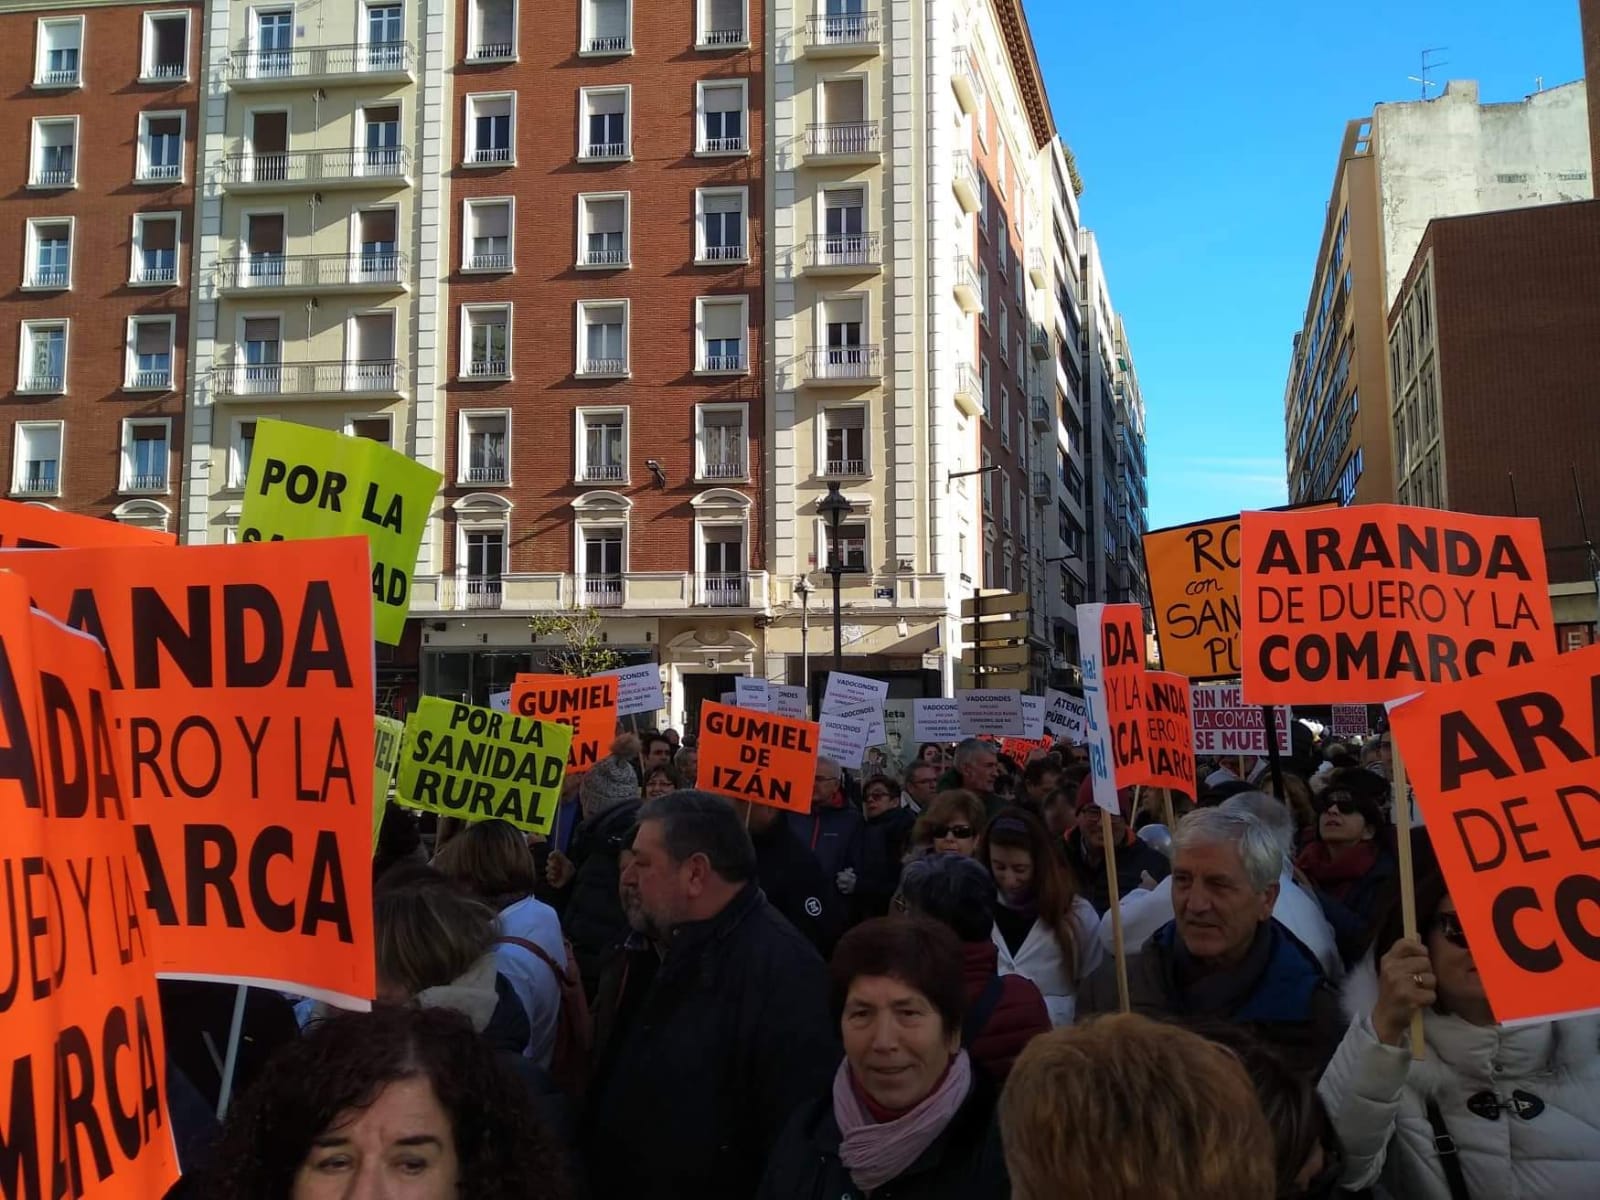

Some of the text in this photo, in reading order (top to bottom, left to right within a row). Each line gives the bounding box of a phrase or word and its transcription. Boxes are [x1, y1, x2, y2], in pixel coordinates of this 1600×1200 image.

[260, 458, 404, 534] POR LA
[1256, 522, 1532, 581] ARANDA
[1185, 577, 1224, 596] con
[1258, 580, 1540, 630] DE DUERO Y LA
[518, 684, 615, 717] GUMIEL
[1193, 688, 1215, 708] SIN
[1195, 710, 1285, 729] LA COMARA
[449, 704, 544, 748] POR LA
[705, 711, 812, 754] GUMIEL
[1046, 710, 1080, 732] PÚBLICA
[1195, 731, 1215, 751] SE
[1440, 674, 1600, 792] AR
[235, 716, 271, 798] Y
[294, 716, 356, 804] LA
[412, 729, 564, 790] SANIDAD
[739, 744, 770, 768] DE
[412, 768, 545, 826] RURAL
[712, 765, 792, 804] IZÁN
[1452, 796, 1551, 873] DE
[65, 856, 98, 976] Y
[105, 855, 147, 966] LA
